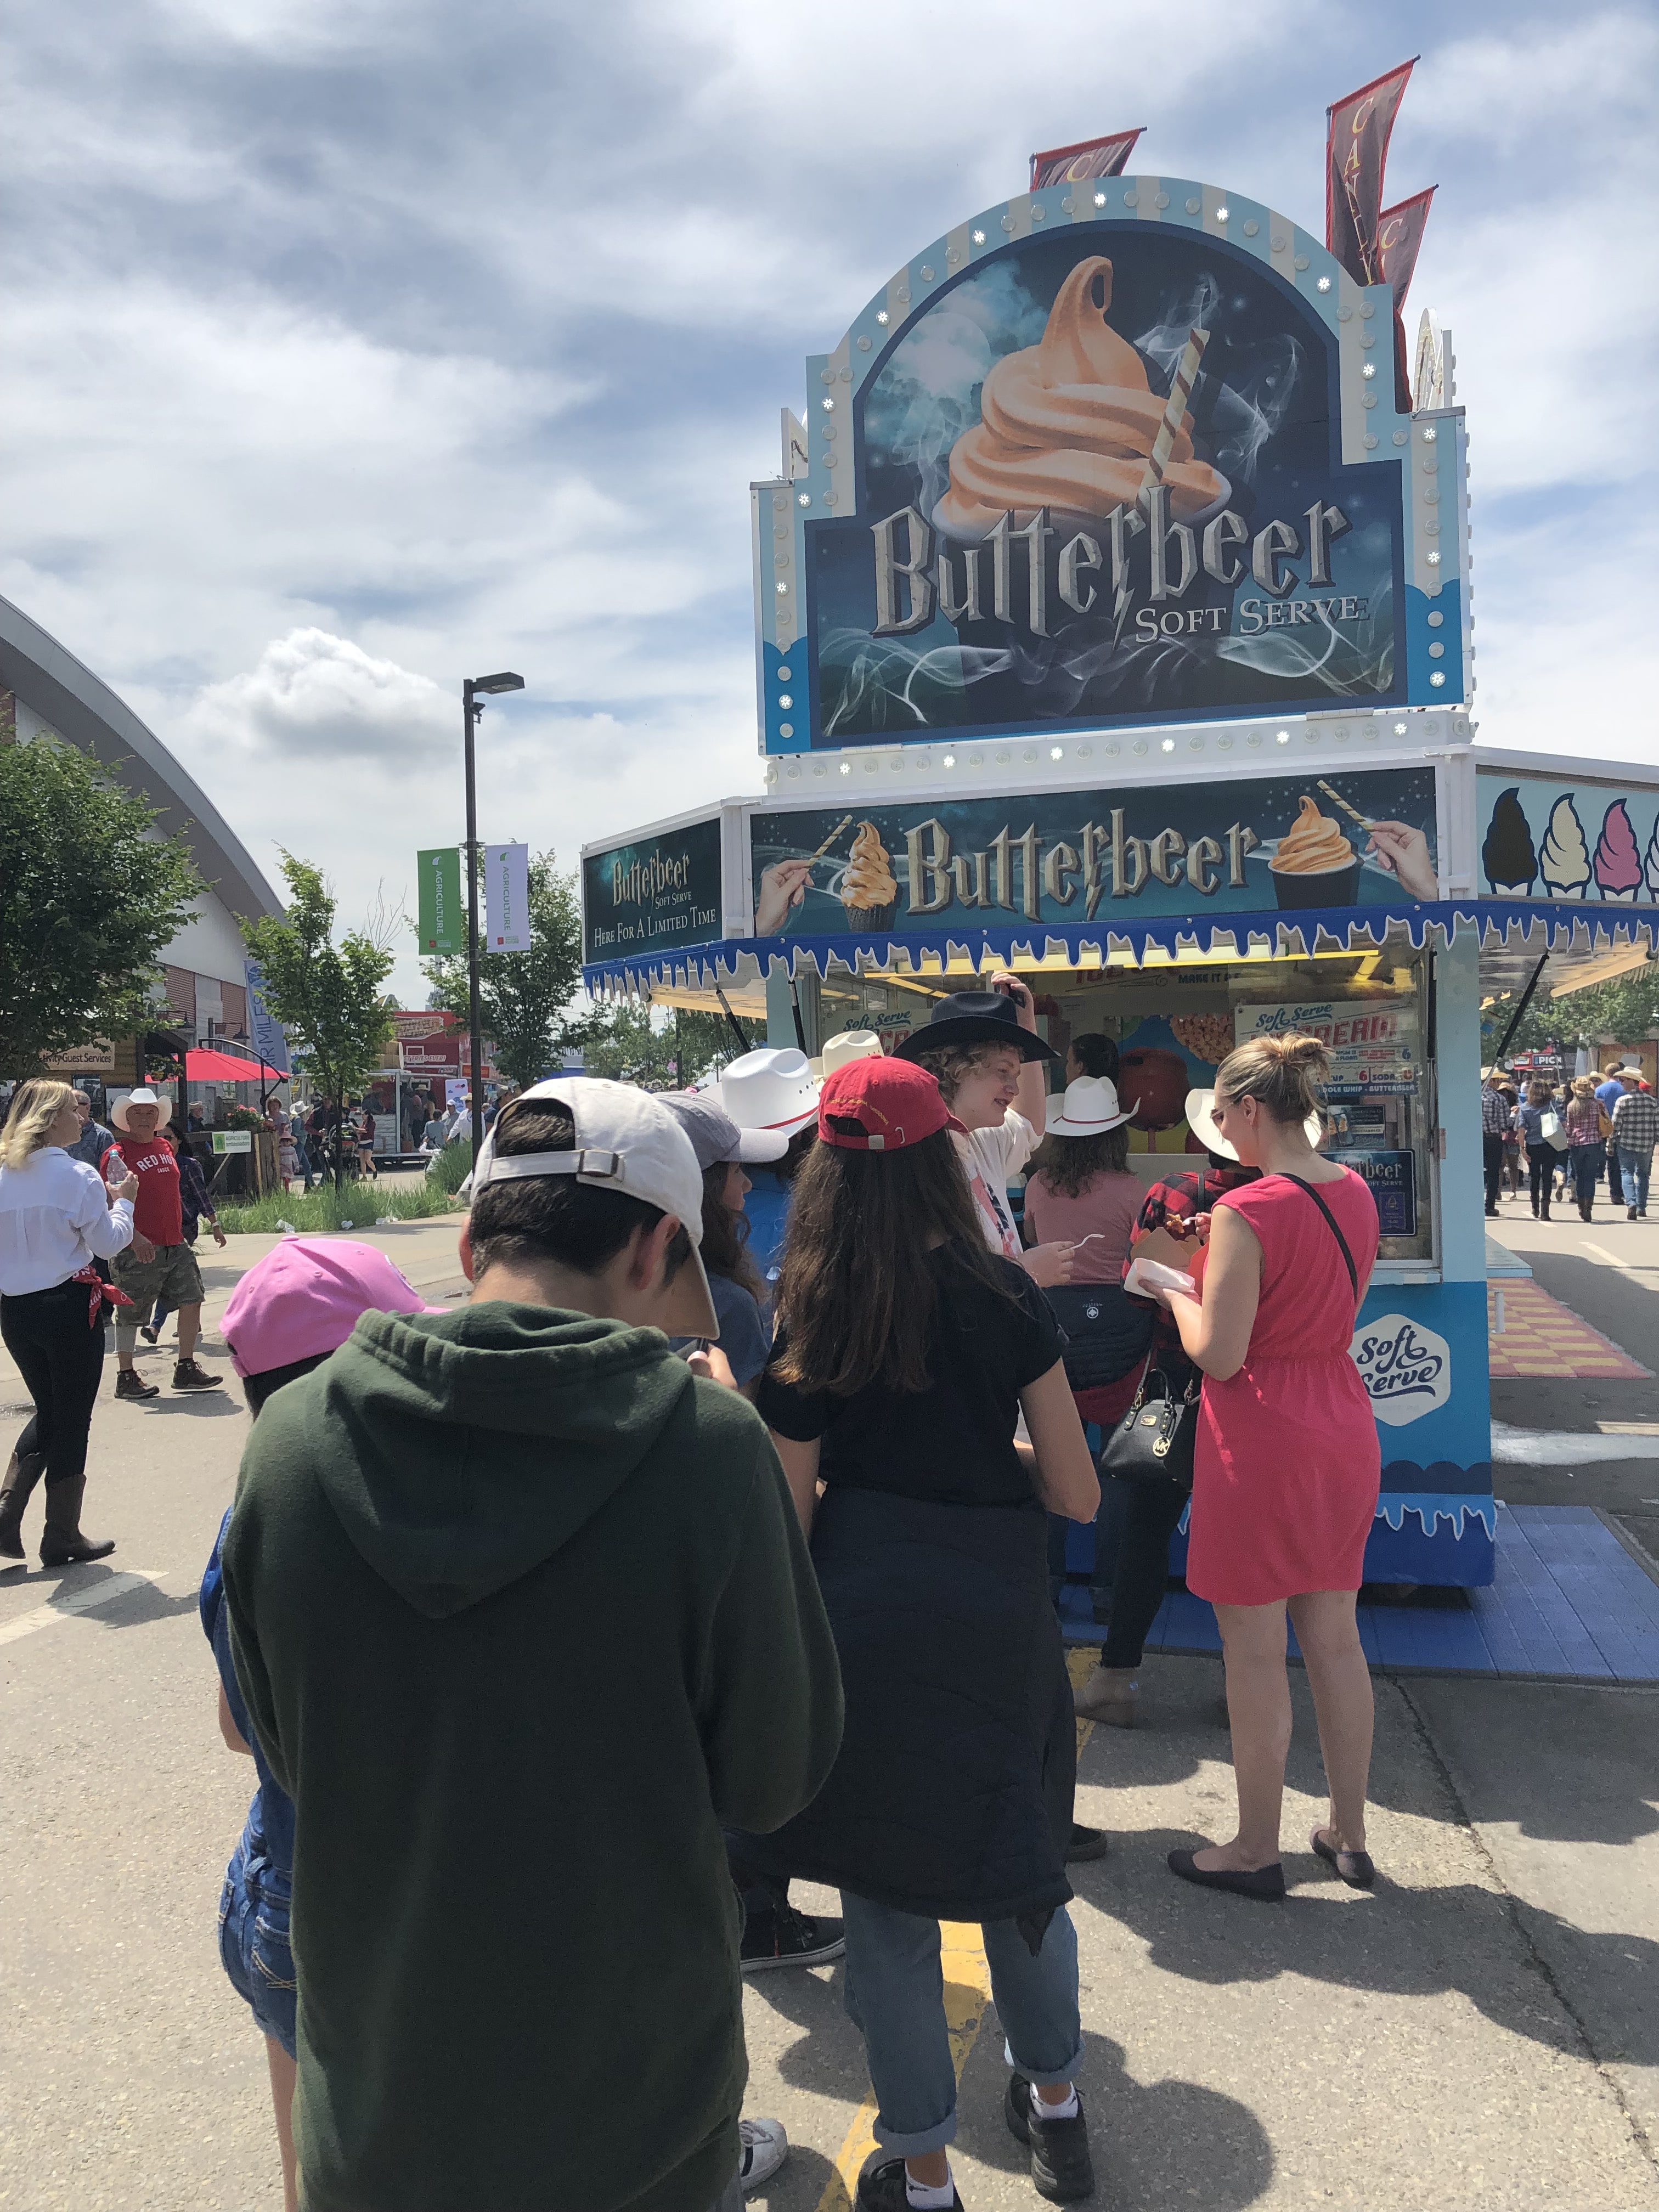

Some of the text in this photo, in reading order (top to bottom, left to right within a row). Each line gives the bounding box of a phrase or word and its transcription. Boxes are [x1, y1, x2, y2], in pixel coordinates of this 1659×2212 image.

[871, 484, 1350, 650] Butterbeer
[1136, 596, 1359, 643] SOFT SERVE
[612, 849, 691, 910] Butterbeer
[904, 808, 1261, 922] Butterbeer
[435, 870, 444, 934] AGRICULTURE
[503, 866, 511, 931] AGRICULTURE
[655, 891, 692, 910] SOFT SERVE
[594, 906, 716, 947] HERE FOR A LIMITED TIME
[843, 1011, 912, 1032] Soft Serve
[1255, 1005, 1333, 1032] Soft Serve
[41, 1053, 111, 1065] tivity Guest Services
[136, 1155, 159, 1171] RED
[1356, 1324, 1428, 1374] Soft
[1361, 1364, 1438, 1399] Serve
[1154, 1440, 1169, 1452] MK
